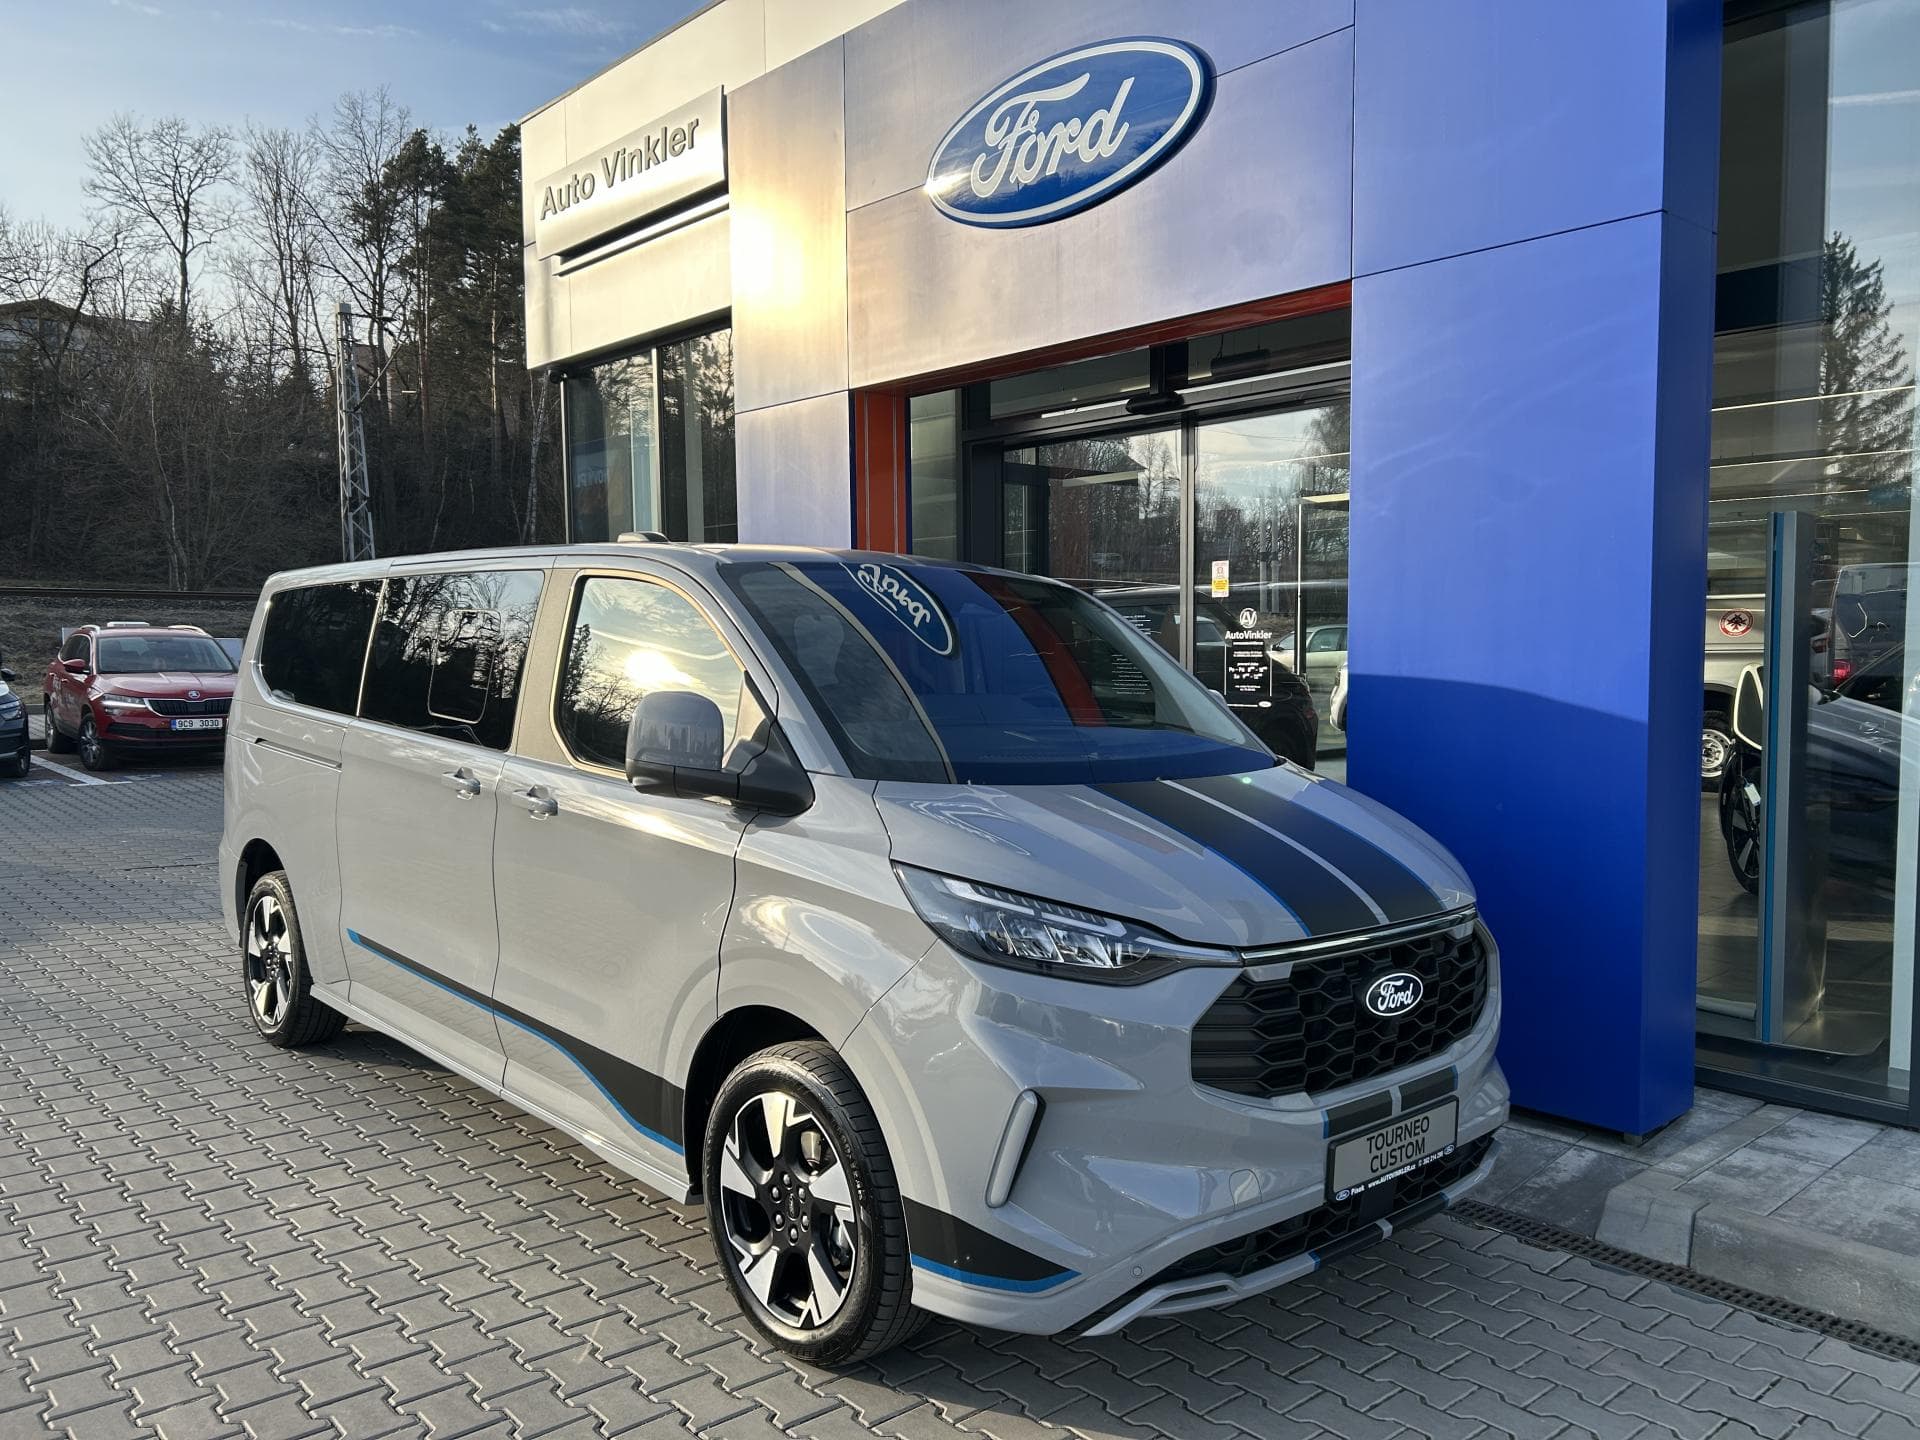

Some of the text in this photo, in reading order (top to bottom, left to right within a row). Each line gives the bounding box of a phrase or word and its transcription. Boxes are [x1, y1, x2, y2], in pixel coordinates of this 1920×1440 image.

[970, 72, 1135, 198] Ford
[540, 118, 699, 221] Auto Vinkler
[1225, 630, 1273, 640] AutoVinkler
[199, 719, 219, 727] 3030
[1377, 979, 1414, 1011] Ford
[1367, 1115, 1430, 1154] TOURNEO
[1370, 1137, 1426, 1173] CUSTOM
